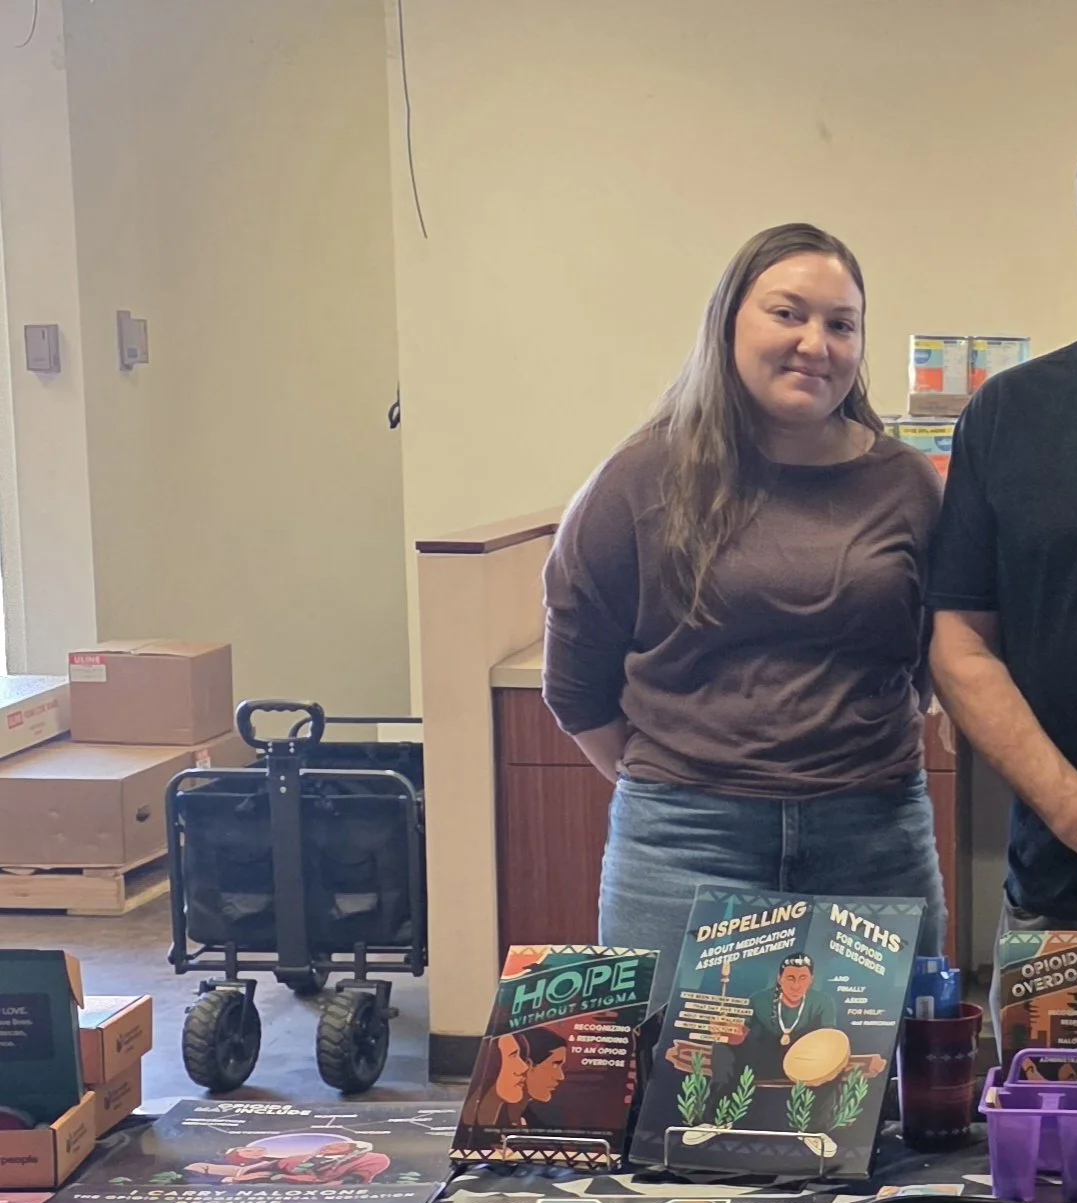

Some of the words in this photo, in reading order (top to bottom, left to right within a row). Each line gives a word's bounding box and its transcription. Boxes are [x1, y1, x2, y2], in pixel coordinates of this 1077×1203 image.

[74, 655, 100, 664] ULINE
[697, 901, 807, 942] DISPELLING
[831, 903, 901, 953] MYTHS
[695, 952, 740, 970] ASSISTED
[743, 937, 797, 960] TREATMENT
[700, 942, 735, 959] ABOUT
[736, 927, 796, 952] MEDICATION
[837, 931, 854, 946] FOR
[854, 941, 883, 961] OPIOID
[830, 940, 846, 955] USE
[845, 948, 886, 976] DISORDER
[1021, 951, 1077, 978] OPIOID
[512, 959, 639, 1015] HOPE
[509, 1003, 577, 1028] WITHOUT
[581, 991, 637, 1011] STIGMA
[574, 1024, 631, 1032] RECOGNIZING
[576, 1035, 629, 1044] RESPONDING
[581, 1058, 625, 1067] OVERDOSE
[194, 1105, 230, 1113] MAY
[235, 1108, 311, 1116] INCLUDE
[218, 1103, 293, 1111] OPIOIDS
[1, 1154, 38, 1166] people
[324, 1192, 414, 1200] MEDICATION
